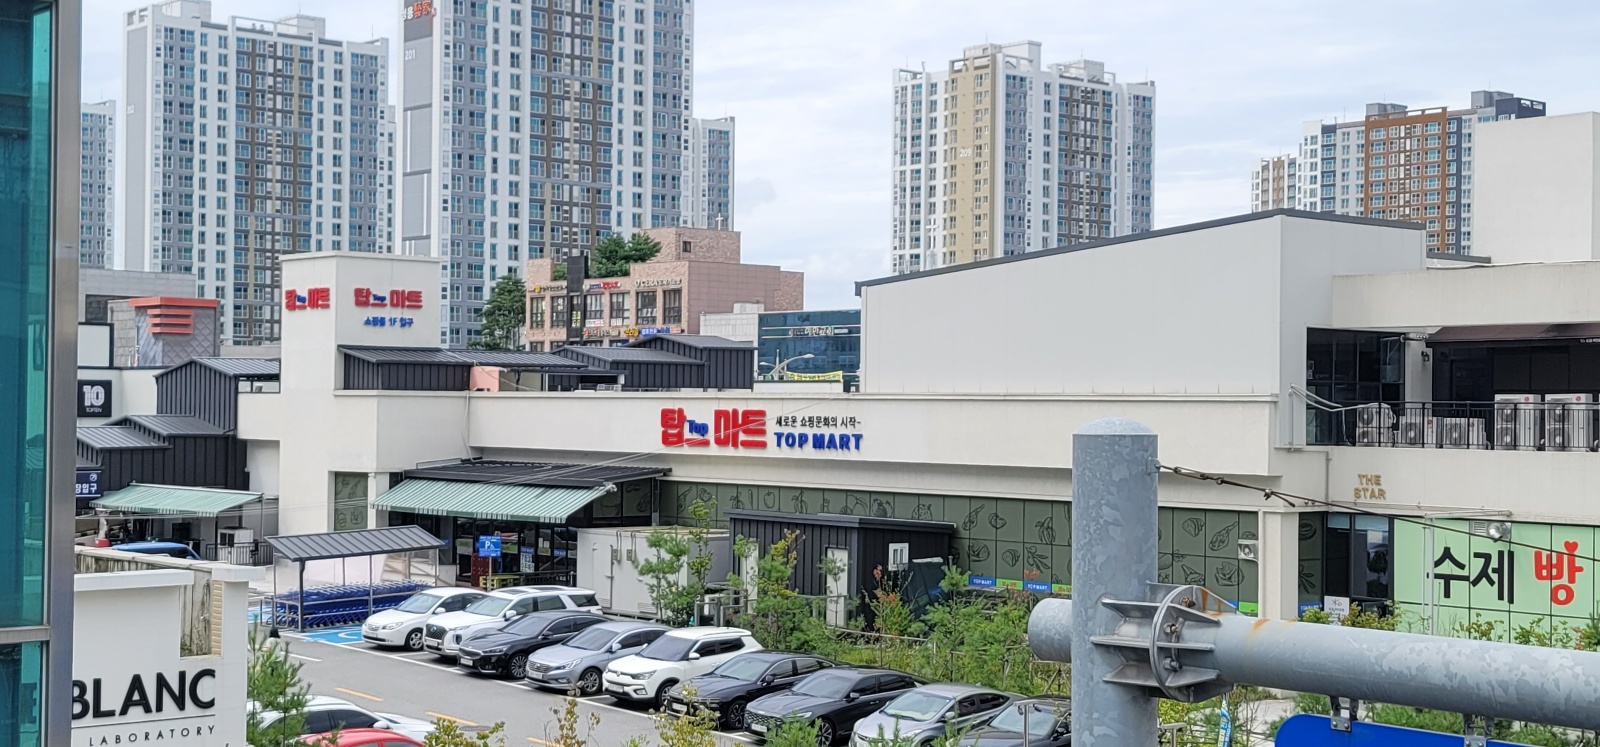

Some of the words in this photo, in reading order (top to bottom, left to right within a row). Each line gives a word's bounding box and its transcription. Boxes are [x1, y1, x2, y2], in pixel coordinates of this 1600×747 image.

[404, 49, 416, 60] 201
[389, 289, 423, 309] 마트
[388, 316, 398, 327] 1F
[83, 385, 105, 406] 10
[660, 407, 687, 448] 탑
[686, 419, 709, 438] Top
[714, 407, 767, 450] 마트
[775, 415, 798, 428] 새로운
[800, 415, 838, 429] 쇼핑문화의
[773, 432, 809, 449] TOP
[812, 433, 864, 451] MART
[1358, 474, 1382, 486] THE
[1353, 487, 1387, 500] STAR
[1426, 546, 1515, 604] 수제
[1534, 540, 1584, 606] 빵
[72, 668, 216, 720] BLANC
[89, 725, 215, 747] LABORATORY
